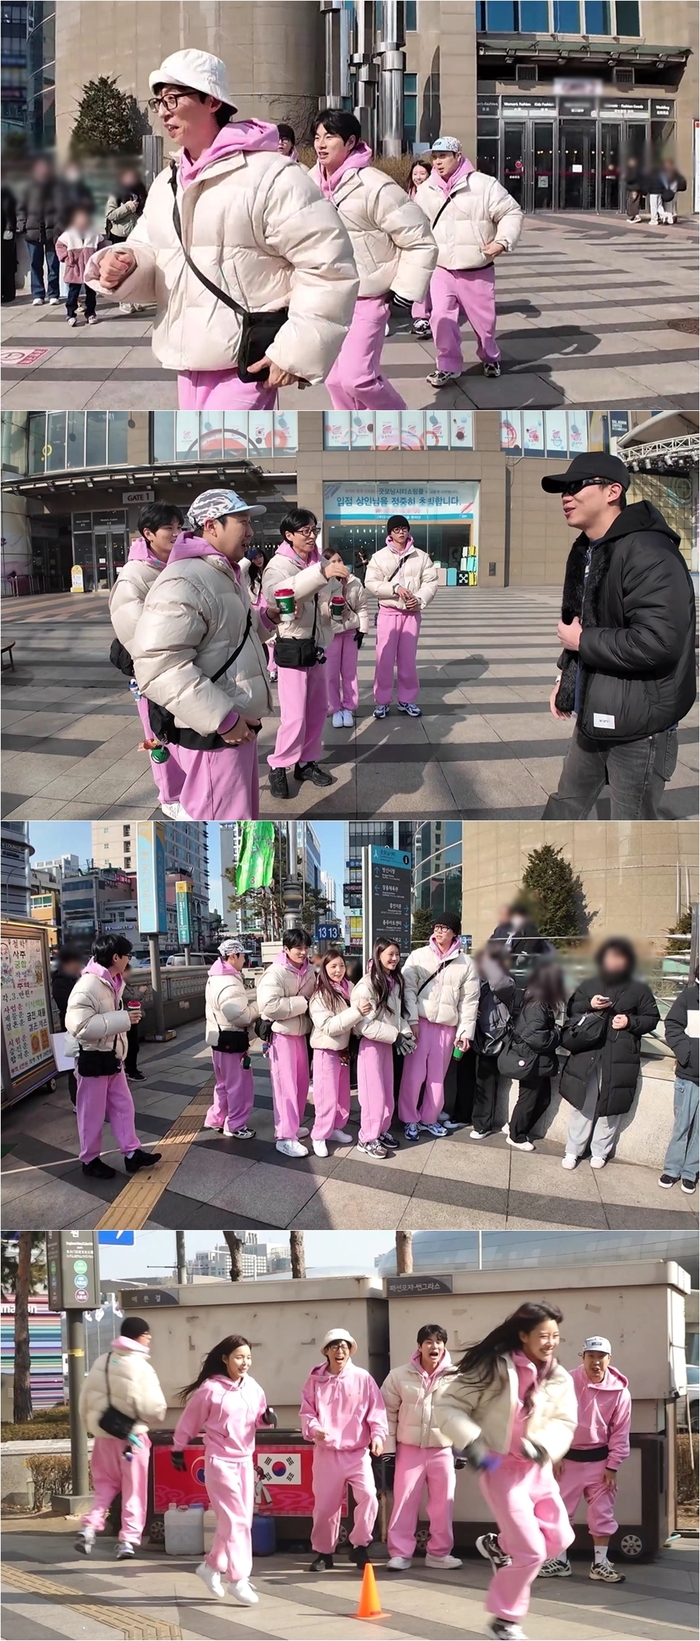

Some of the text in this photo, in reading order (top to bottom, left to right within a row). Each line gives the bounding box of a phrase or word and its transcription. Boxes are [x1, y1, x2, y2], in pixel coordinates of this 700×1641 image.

[127, 494, 144, 502] GATE
[336, 496, 353, 506] 입점
[355, 496, 388, 506] 상인님을
[391, 496, 416, 507] 정중히
[318, 927, 338, 939] 13 13
[13, 950, 26, 959] 사주
[14, 960, 27, 969] 궁합
